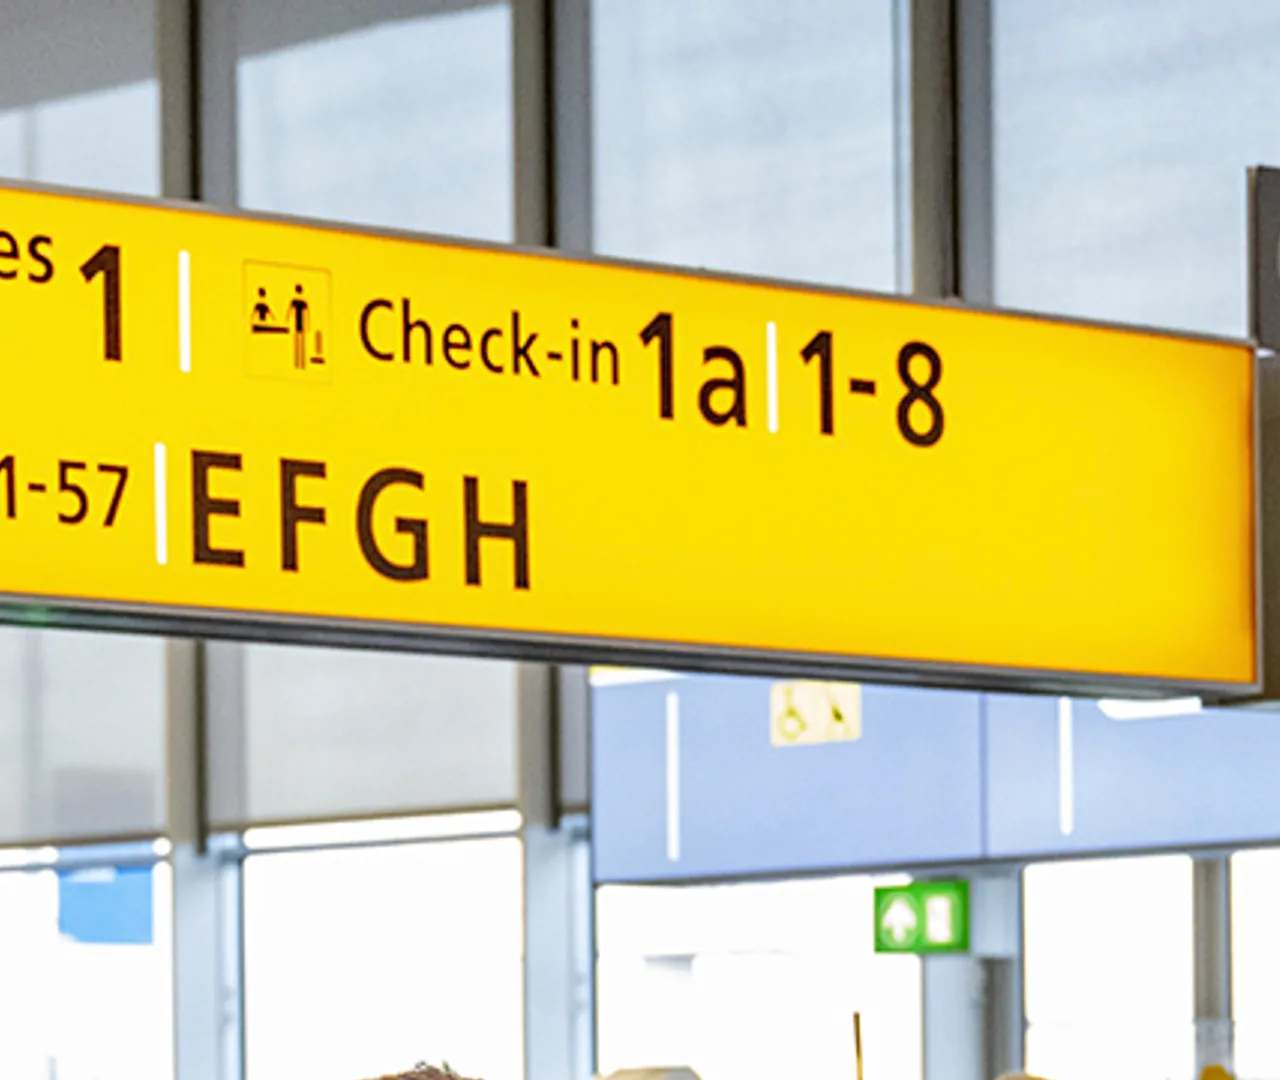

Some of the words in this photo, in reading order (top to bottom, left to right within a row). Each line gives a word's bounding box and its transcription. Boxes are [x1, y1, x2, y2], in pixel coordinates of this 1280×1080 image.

[78, 243, 123, 362] 1
[358, 297, 620, 386] Check-in
[637, 311, 748, 428] 1a
